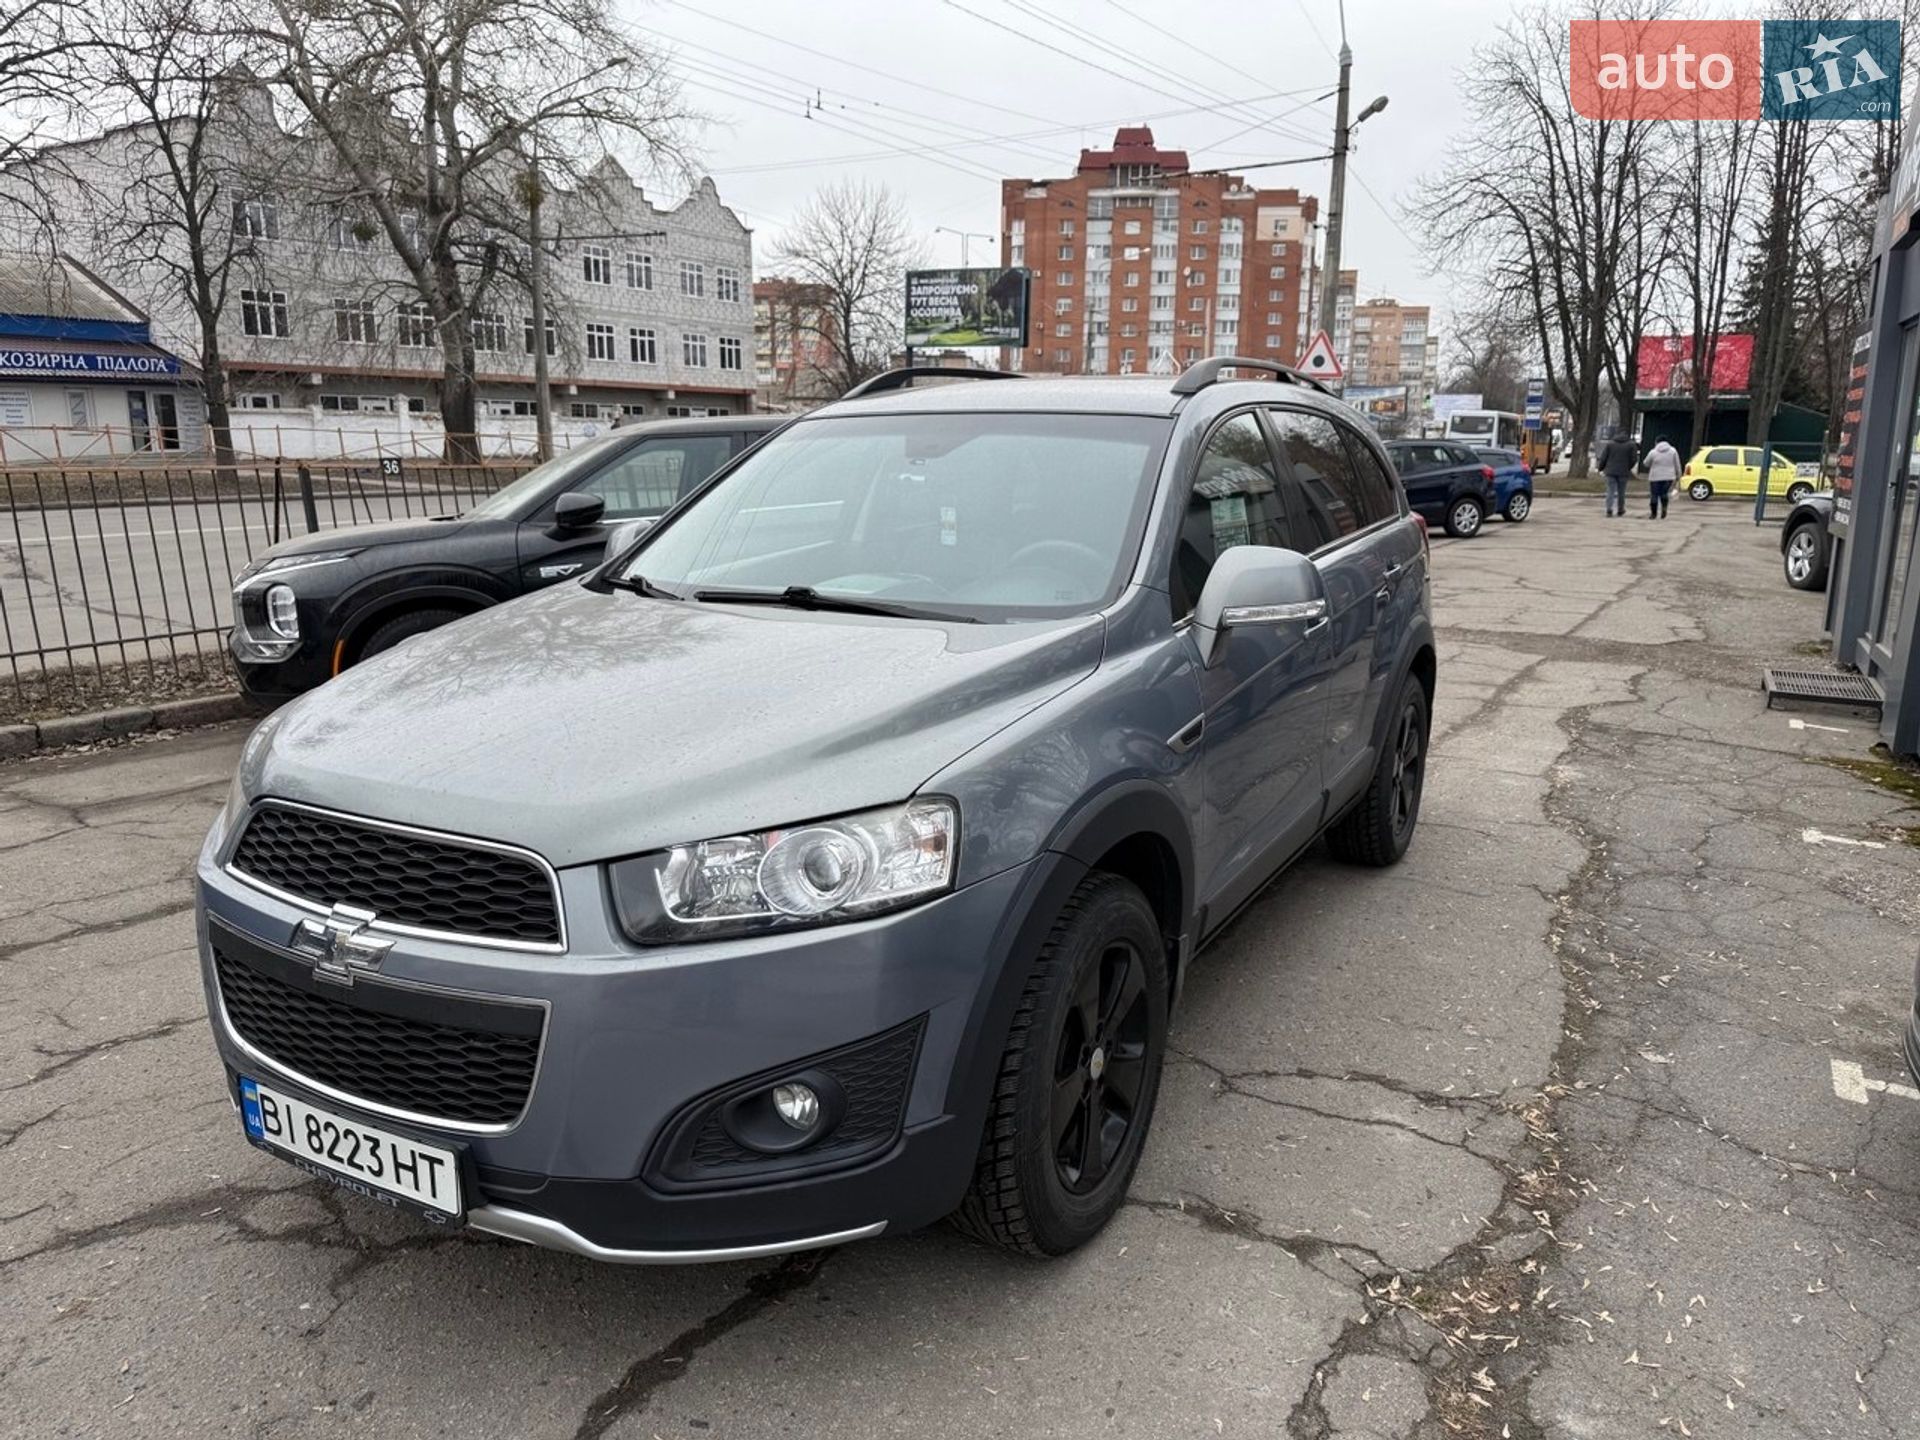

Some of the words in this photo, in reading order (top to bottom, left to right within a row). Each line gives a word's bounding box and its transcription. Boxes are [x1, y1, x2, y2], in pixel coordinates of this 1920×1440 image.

[929, 295, 960, 306] ВЕСНА
[0, 352, 88, 370] КОЗИРНА
[96, 355, 169, 372] ПІДЛОГА
[383, 460, 400, 474] 36
[248, 1113, 261, 1128] UA
[304, 1113, 385, 1178] 8223
